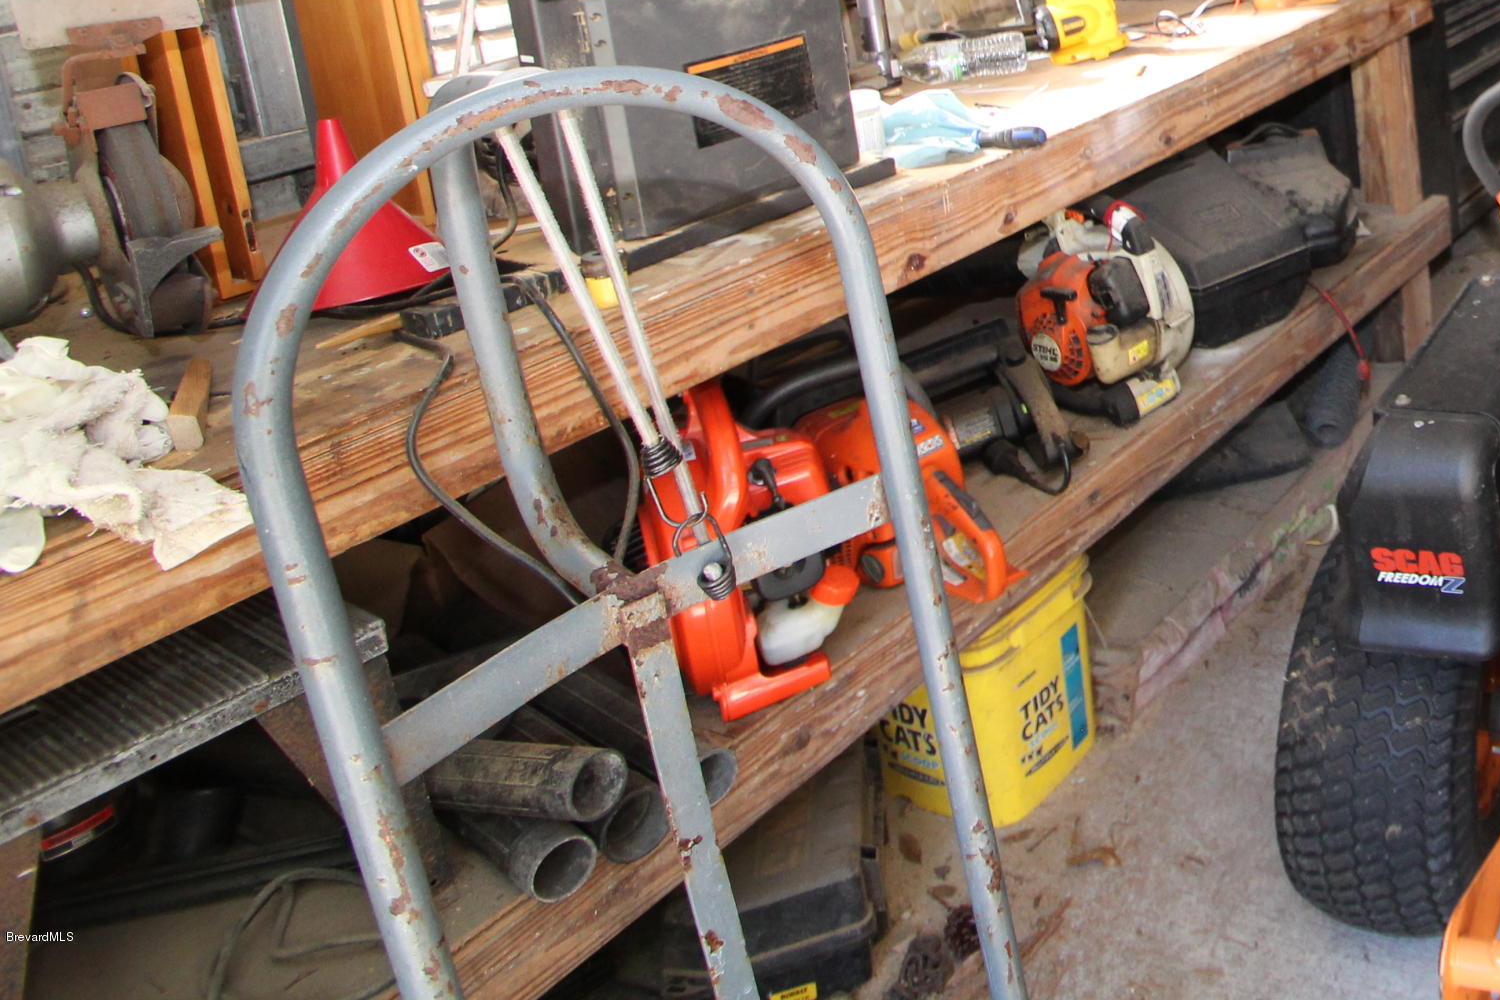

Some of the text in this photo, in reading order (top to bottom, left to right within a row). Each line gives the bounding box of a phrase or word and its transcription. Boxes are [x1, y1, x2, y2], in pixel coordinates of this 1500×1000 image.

[1370, 547, 1465, 577] SCAG
[1019, 674, 1060, 720] TIDY
[890, 702, 927, 729] IDY
